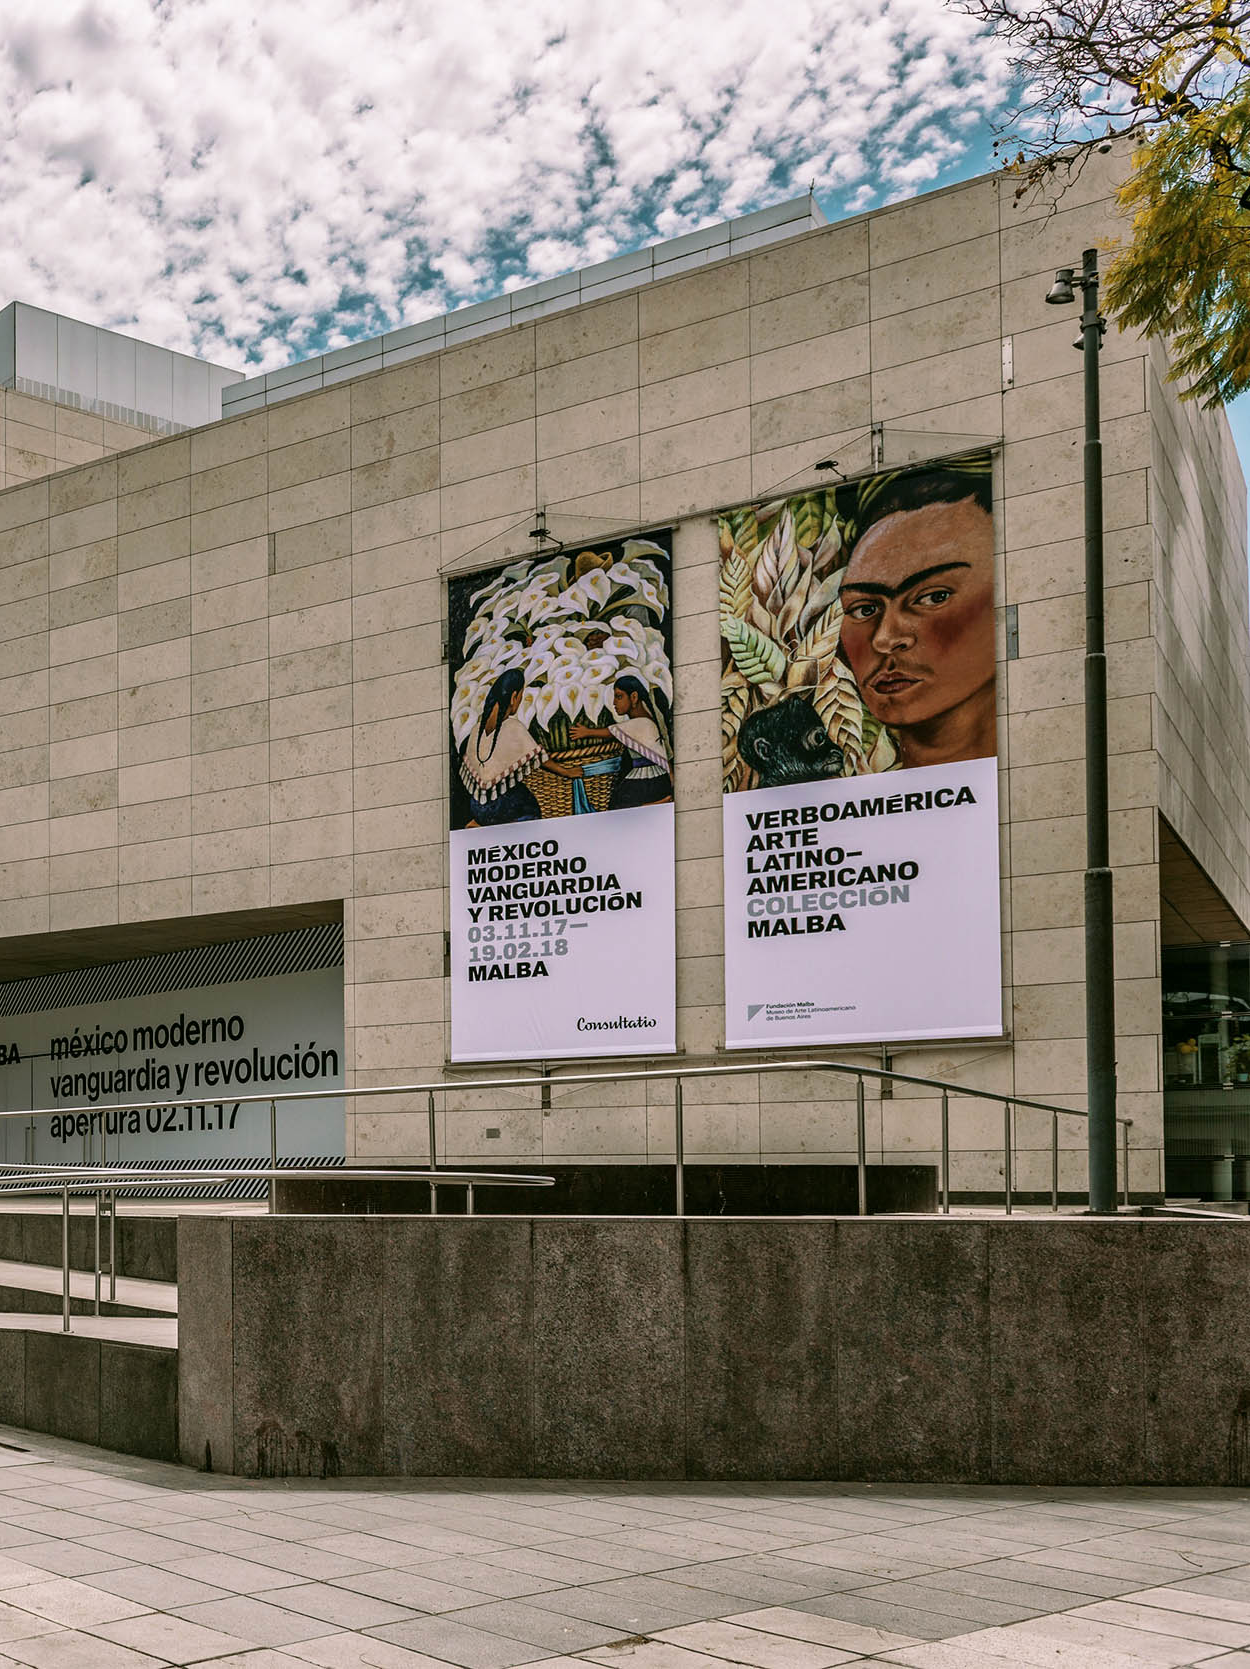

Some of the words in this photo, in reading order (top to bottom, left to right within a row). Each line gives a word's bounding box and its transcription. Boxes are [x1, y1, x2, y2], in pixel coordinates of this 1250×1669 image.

[745, 786, 977, 831] VERBOAMÉRICA
[468, 839, 559, 866] MÉXICO
[746, 828, 818, 853] ARTE
[468, 857, 587, 884] MODERNO
[746, 861, 919, 896] AMERICANO
[468, 874, 620, 904] VANGUARDIA
[747, 884, 910, 917] COLECCIÓN
[468, 907, 483, 923] Y
[489, 891, 642, 922] REVOLUCIÓN
[747, 914, 846, 939] MALBA
[469, 939, 569, 962] 19.02.18
[468, 960, 549, 982] MALBA
[766, 1002, 796, 1010] Fundación
[808, 1005, 856, 1013] Latinoamericano
[50, 1024, 128, 1061] méxico
[133, 1013, 245, 1052] moderno
[577, 1015, 657, 1032] Consultatio
[50, 1058, 170, 1102] vanguardia
[175, 1062, 190, 1096] y
[195, 1041, 339, 1087] revolución
[50, 1110, 141, 1144] apertura
[146, 1100, 241, 1133] 02.11.17
